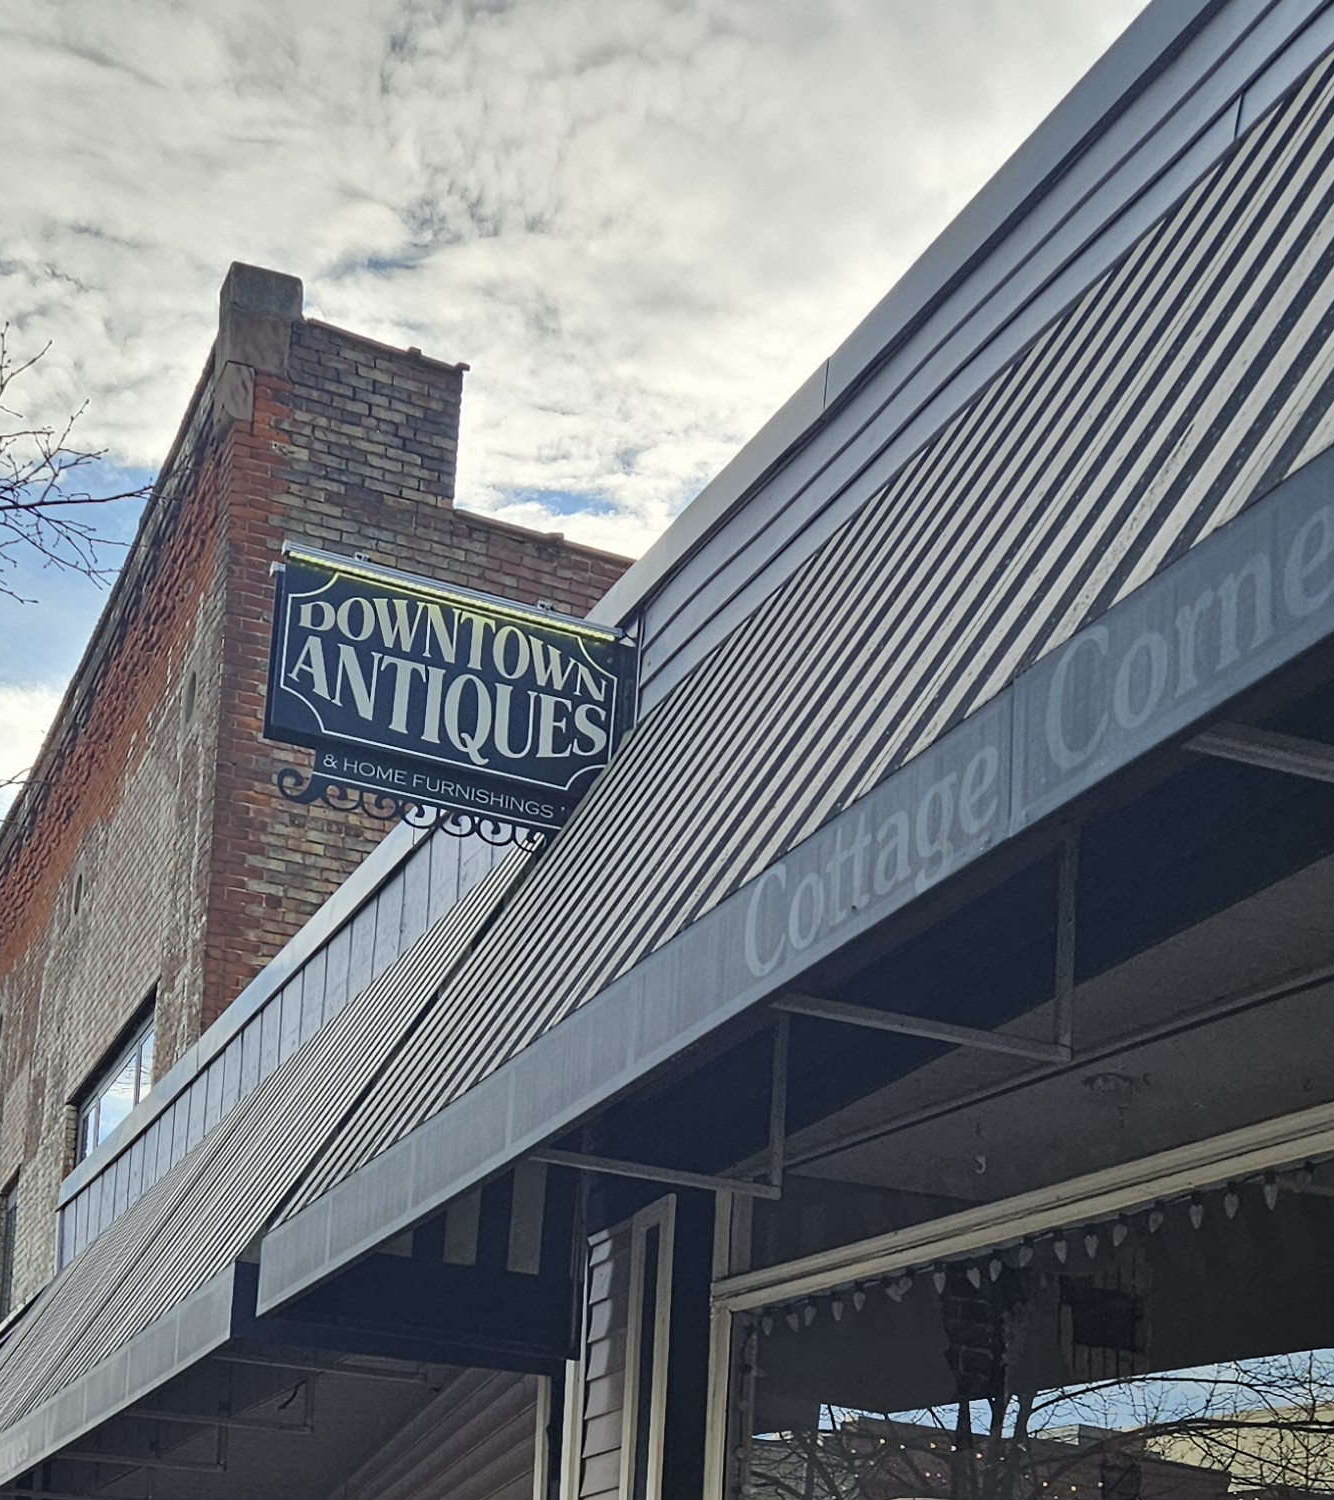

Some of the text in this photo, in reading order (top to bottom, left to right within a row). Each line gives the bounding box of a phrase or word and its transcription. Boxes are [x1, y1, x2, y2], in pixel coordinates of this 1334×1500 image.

[288, 635, 607, 765] ANTIQUES
[299, 597, 608, 701] DOWNTOWN
[323, 753, 555, 819] & HOME FURNISHINGS
[743, 744, 999, 979] Cottage
